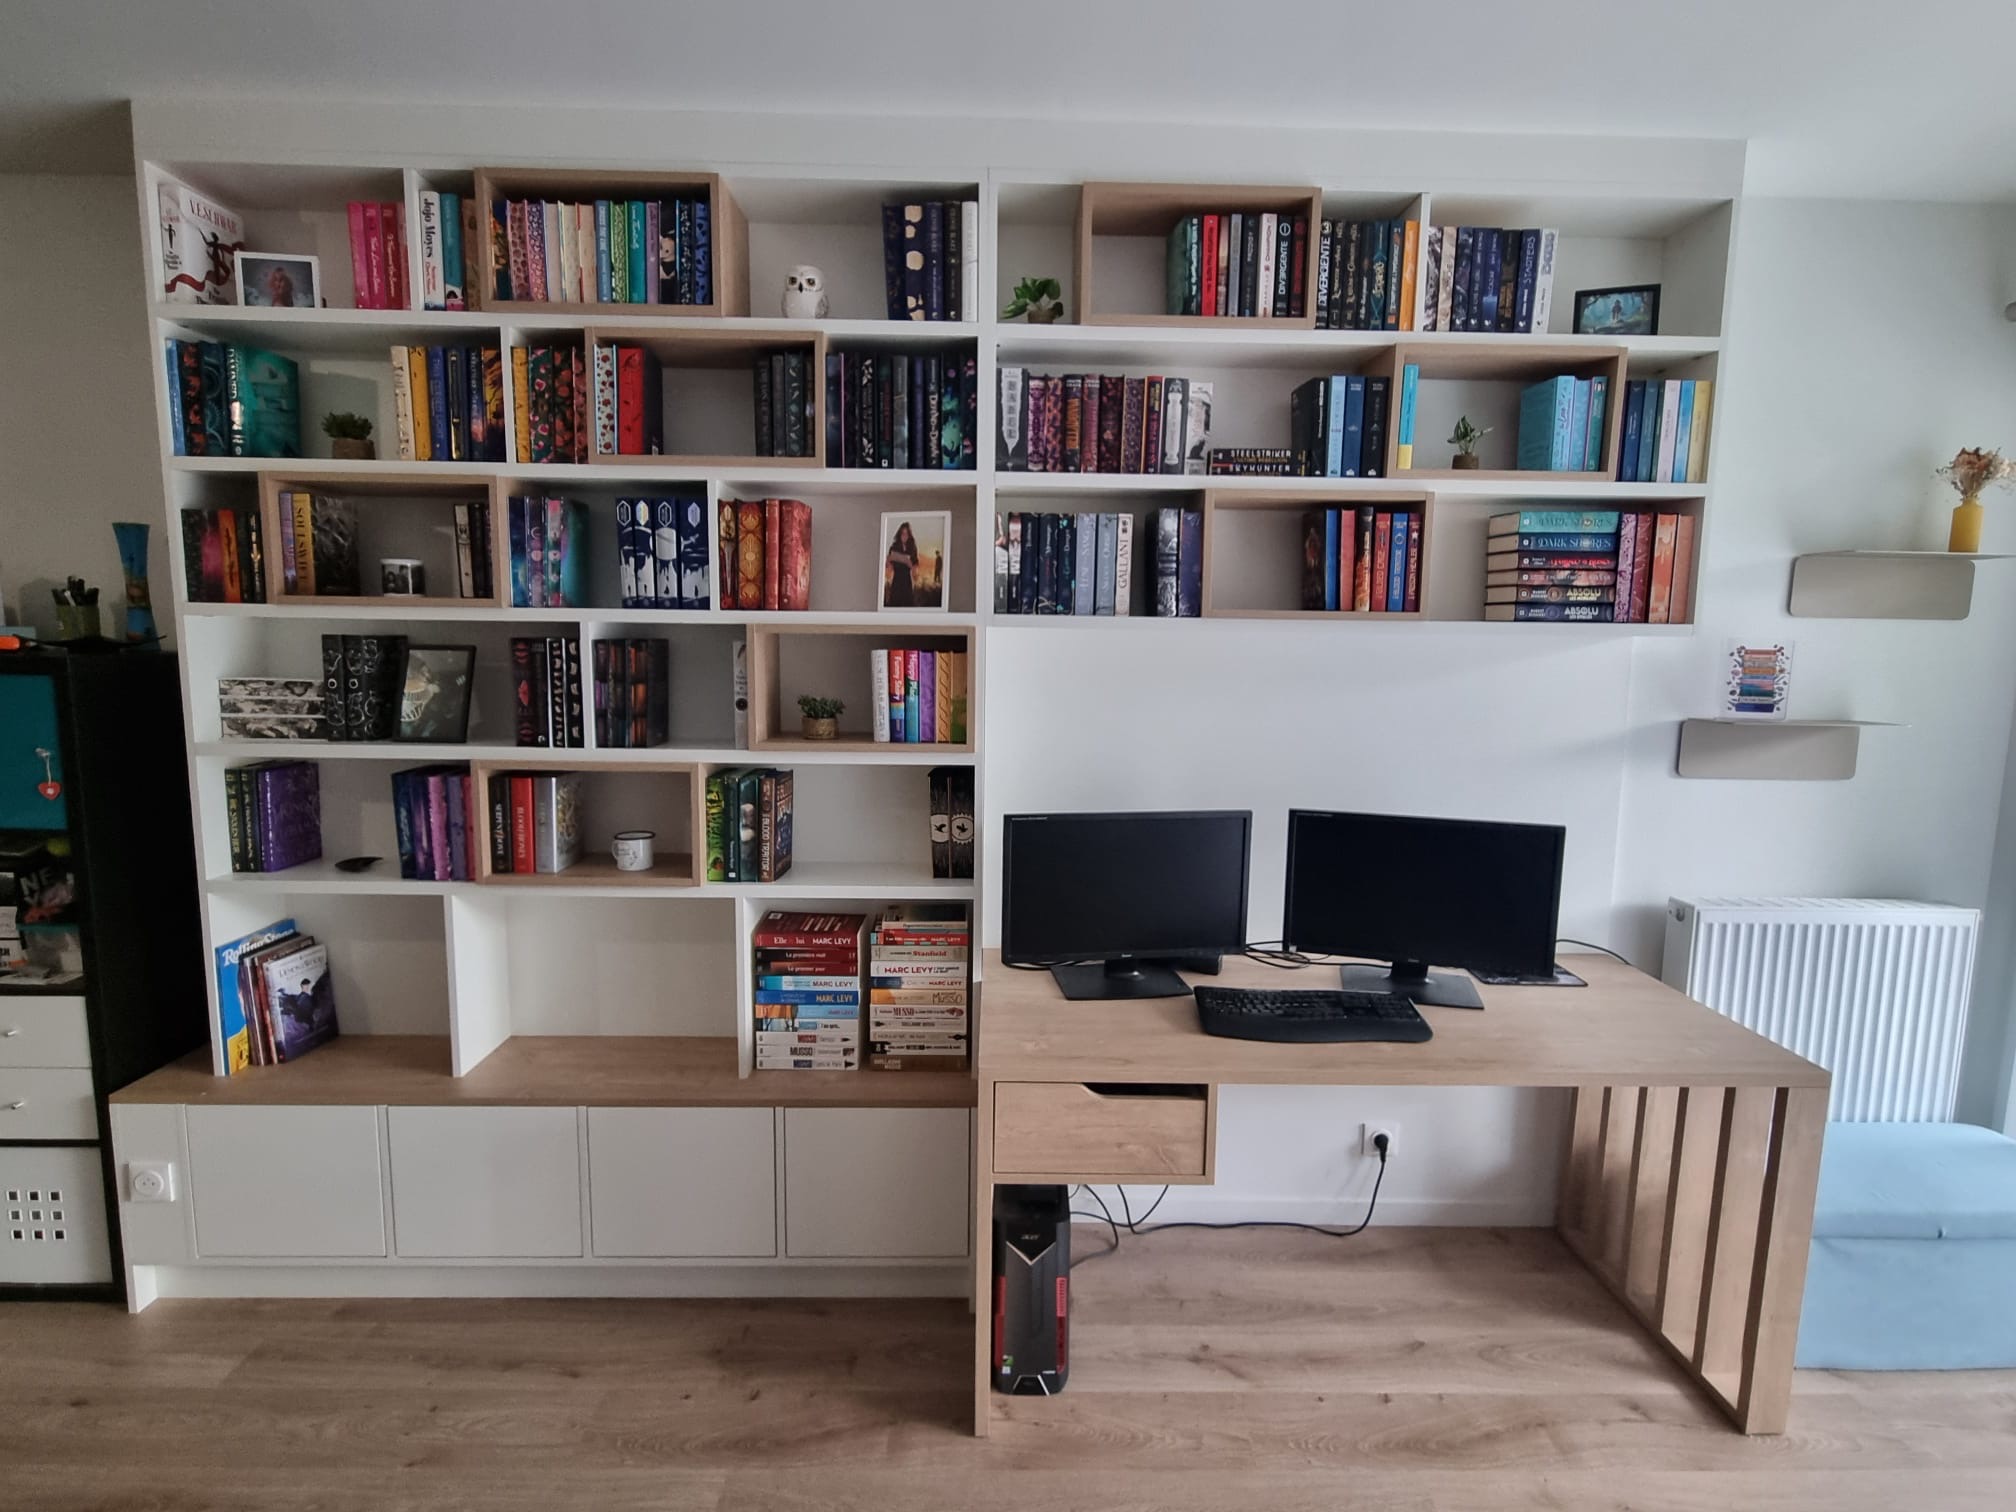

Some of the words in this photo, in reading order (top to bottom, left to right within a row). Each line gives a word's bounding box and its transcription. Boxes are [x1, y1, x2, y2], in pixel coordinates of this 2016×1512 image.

[423, 198, 435, 222] Jojo
[424, 225, 436, 258] Moyes
[1277, 240, 1288, 295] DIVERGENTE
[1318, 236, 1330, 306] DIVERGENTE
[1523, 236, 1535, 284] STARTERS
[1231, 449, 1291, 458] STEELSTRIKER
[1230, 464, 1290, 472] SKYHUNTER
[1537, 538, 1567, 548] DARK
[1118, 538, 1129, 589] GALLANT
[1566, 588, 1601, 597] ABSOLU
[1564, 606, 1599, 616] ABSOLU
[762, 817, 770, 840] BLOOD
[762, 842, 770, 871] TRAITOR
[815, 994, 834, 1002] MARC
[836, 994, 853, 1002] LEVY
[790, 1046, 813, 1056] MUSSO
